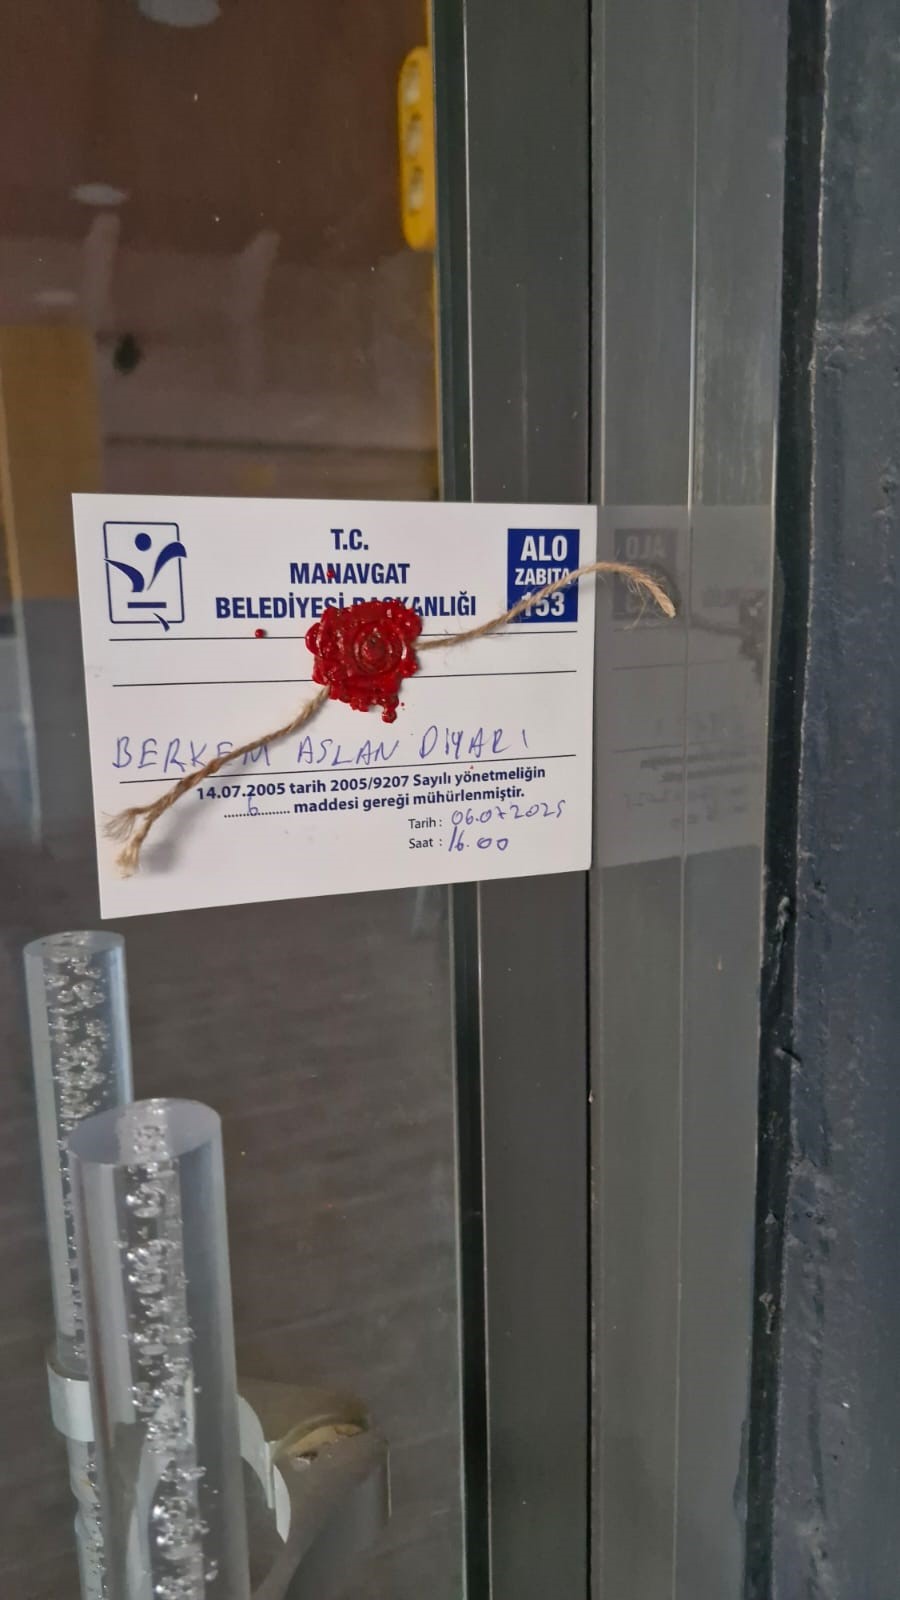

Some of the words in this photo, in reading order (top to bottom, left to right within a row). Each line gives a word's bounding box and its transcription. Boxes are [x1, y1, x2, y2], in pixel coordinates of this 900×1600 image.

[330, 528, 369, 550] T.C.
[520, 535, 568, 561] ALO
[290, 562, 410, 585] MANAVGAT
[514, 567, 572, 586] ZABITA
[352, 591, 477, 617] ANLIĞI
[521, 591, 565, 617] 153
[112, 736, 271, 773] BERKEM
[297, 736, 399, 767] ASLAN
[196, 783, 286, 800] 14.07.2005
[290, 780, 326, 795] tarih
[330, 776, 409, 793] 2005/9207
[413, 772, 451, 790] Sayılı
[455, 766, 546, 788] yönetmeliğin
[294, 797, 359, 814] maddesi
[363, 793, 409, 812] gereği
[413, 786, 525, 806] mühürlenmiştir.
